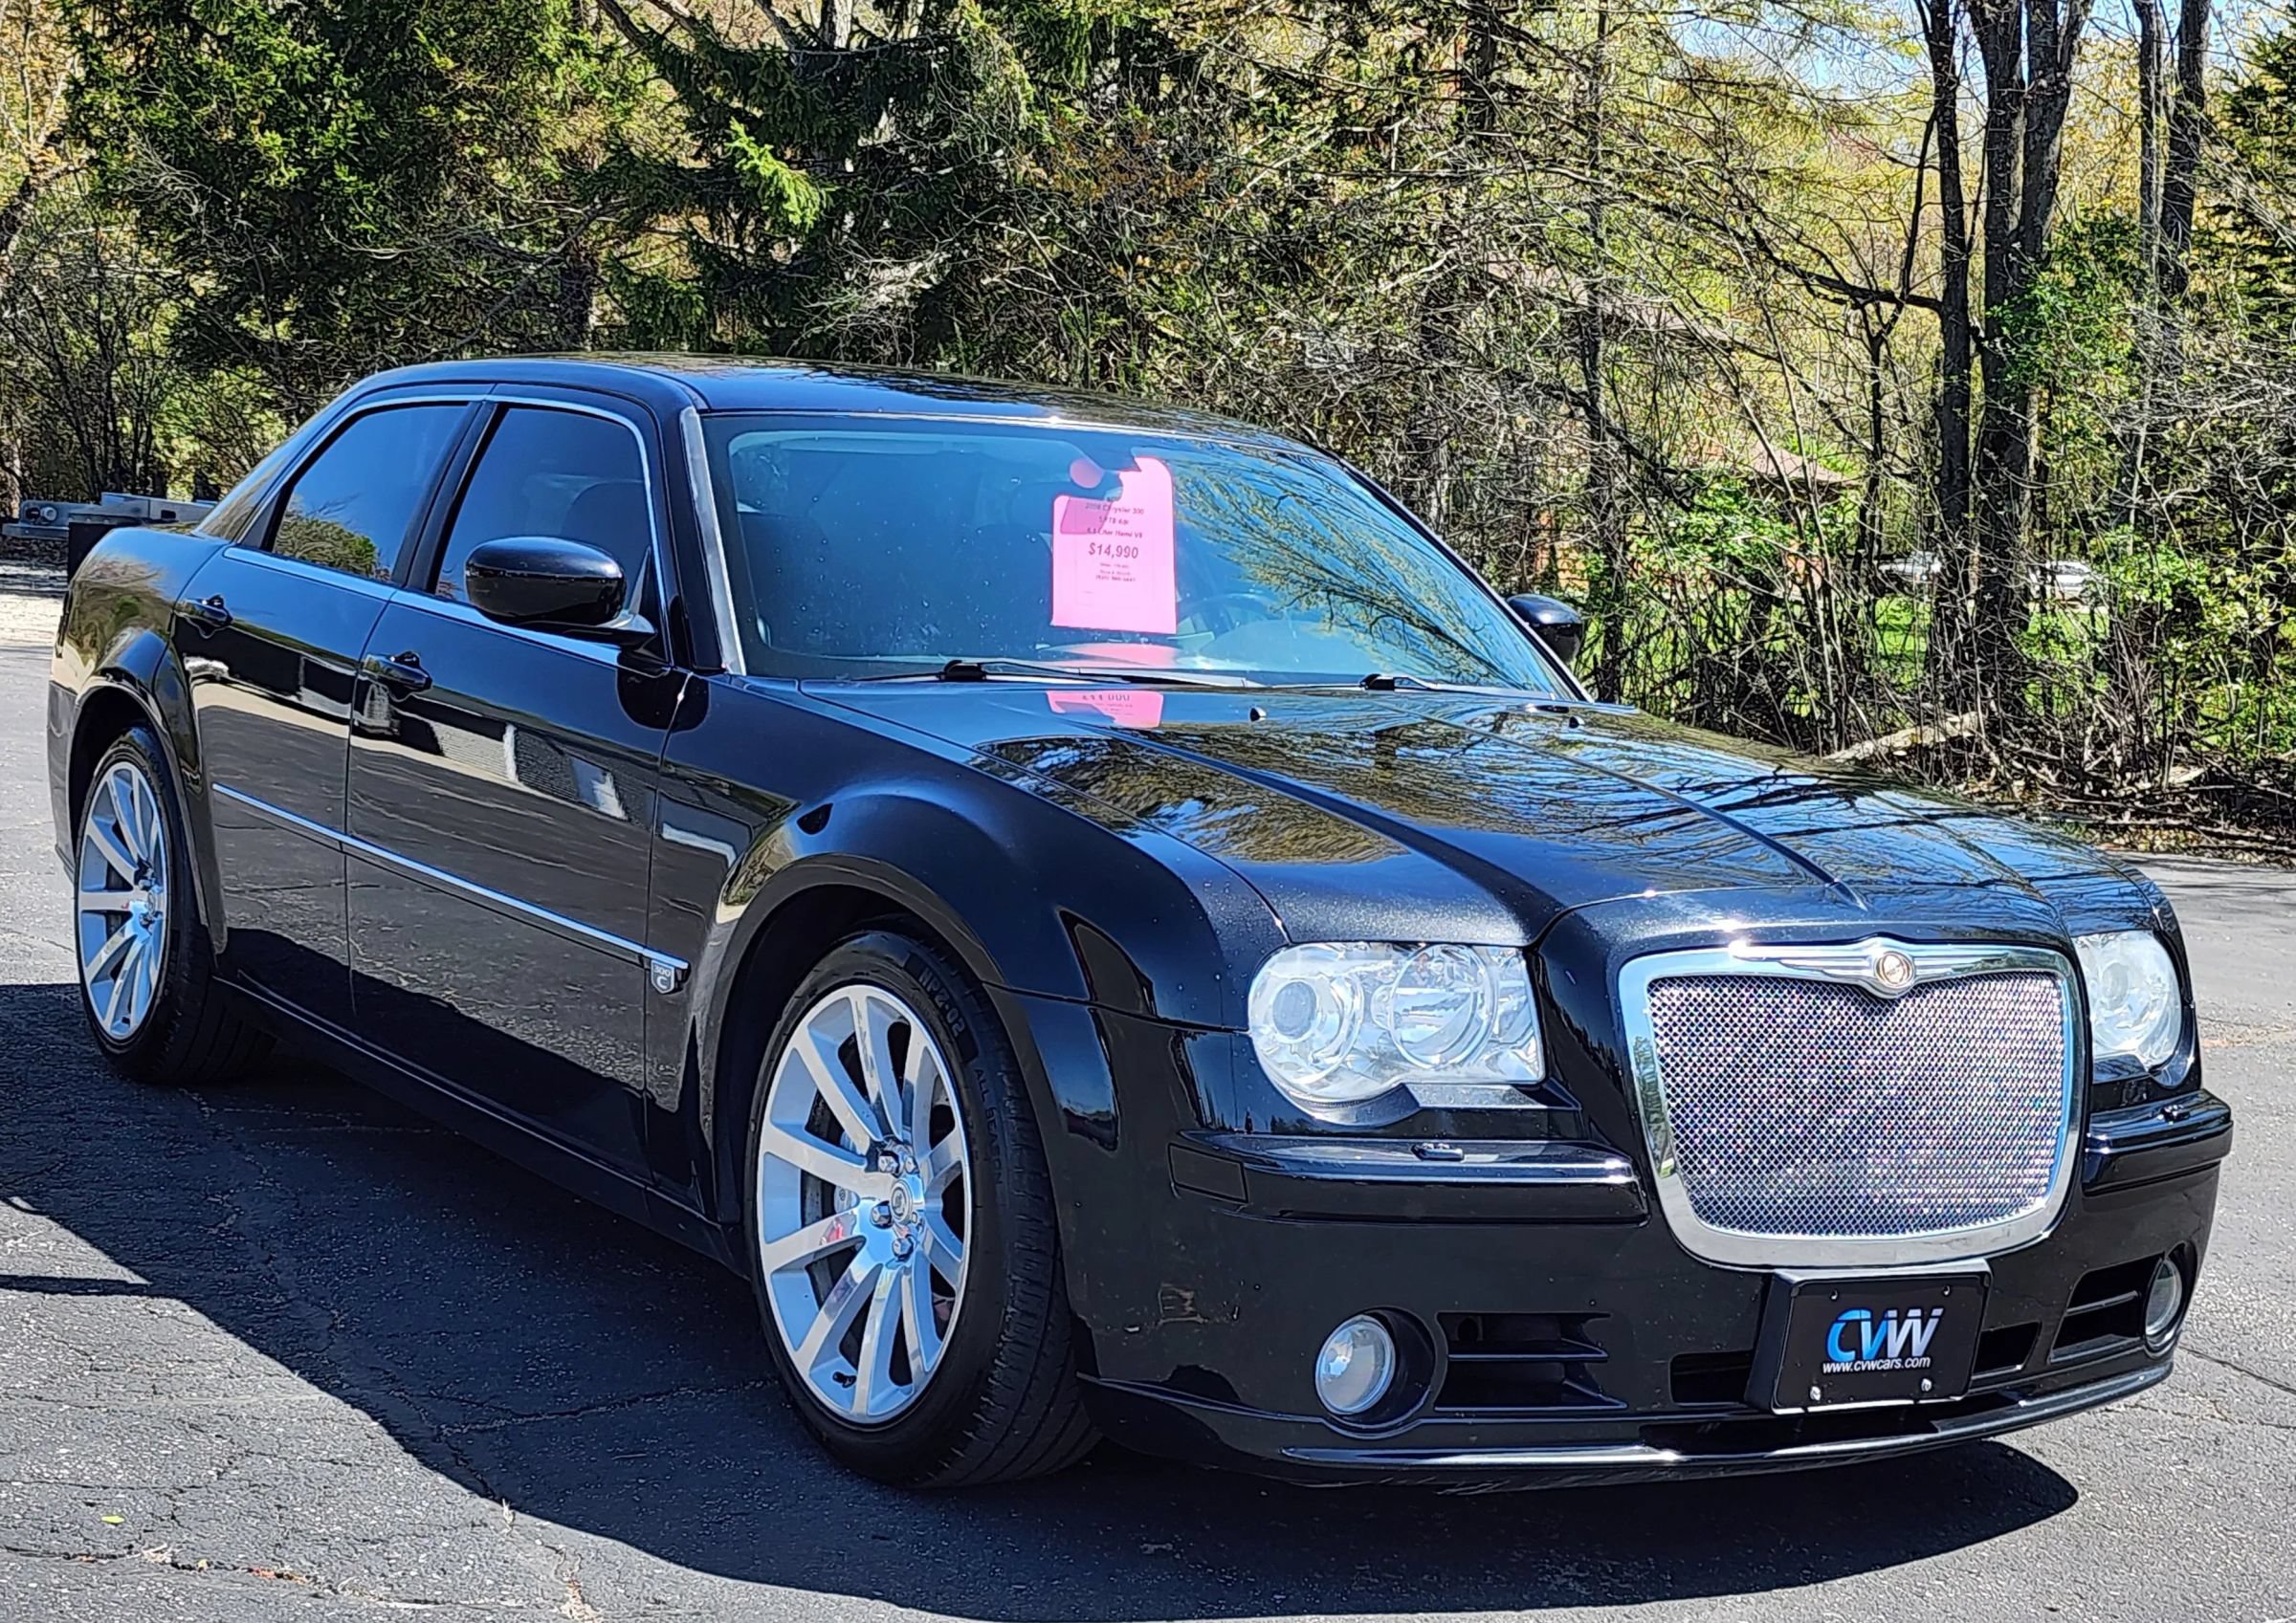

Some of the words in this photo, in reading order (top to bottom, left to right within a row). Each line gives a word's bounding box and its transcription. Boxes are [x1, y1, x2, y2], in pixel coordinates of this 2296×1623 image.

[1089, 542, 1138, 559] $14,990
[654, 965, 671, 977] 300
[656, 976, 668, 990] C
[974, 1068, 989, 1103] ALL
[1827, 1308, 1944, 1362] CVW
[1822, 1356, 1931, 1373] www.cvwcars.com
